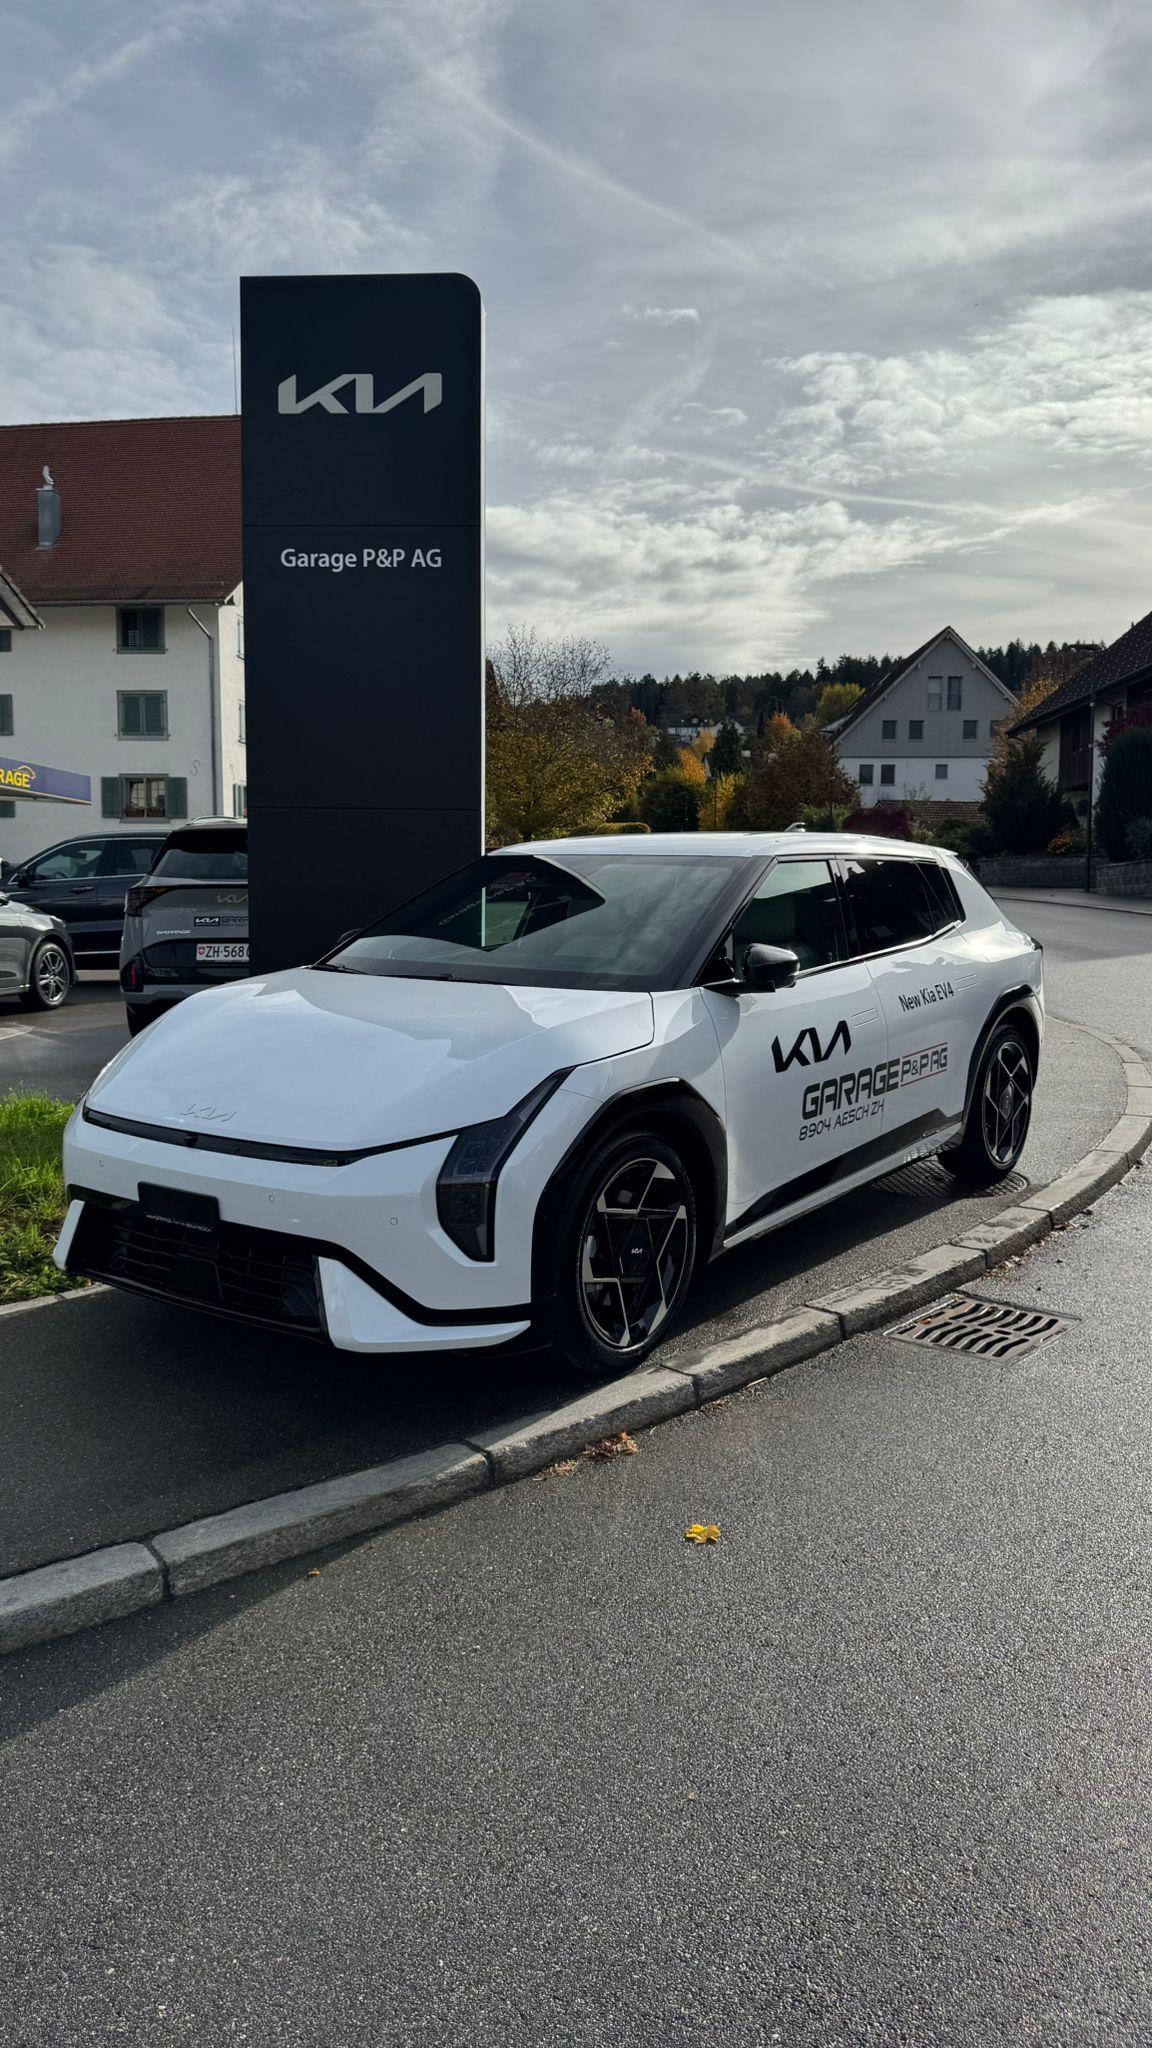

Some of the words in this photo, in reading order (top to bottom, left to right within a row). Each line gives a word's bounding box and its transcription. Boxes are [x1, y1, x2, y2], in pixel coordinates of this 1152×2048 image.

[278, 373, 442, 414] KIA
[280, 549, 357, 573] Garage
[363, 549, 405, 568] P&P
[411, 549, 442, 568] AG
[898, 994, 921, 1012] New
[919, 987, 937, 1005] Kia
[935, 981, 954, 1001] EV4
[771, 1020, 852, 1074] KIA
[802, 1058, 901, 1120] GARAGE
[901, 1054, 929, 1083] P&P
[930, 1047, 948, 1073] AG
[799, 1113, 832, 1141] 8904
[833, 1105, 869, 1130] AESCH
[870, 1099, 885, 1117] ZH
